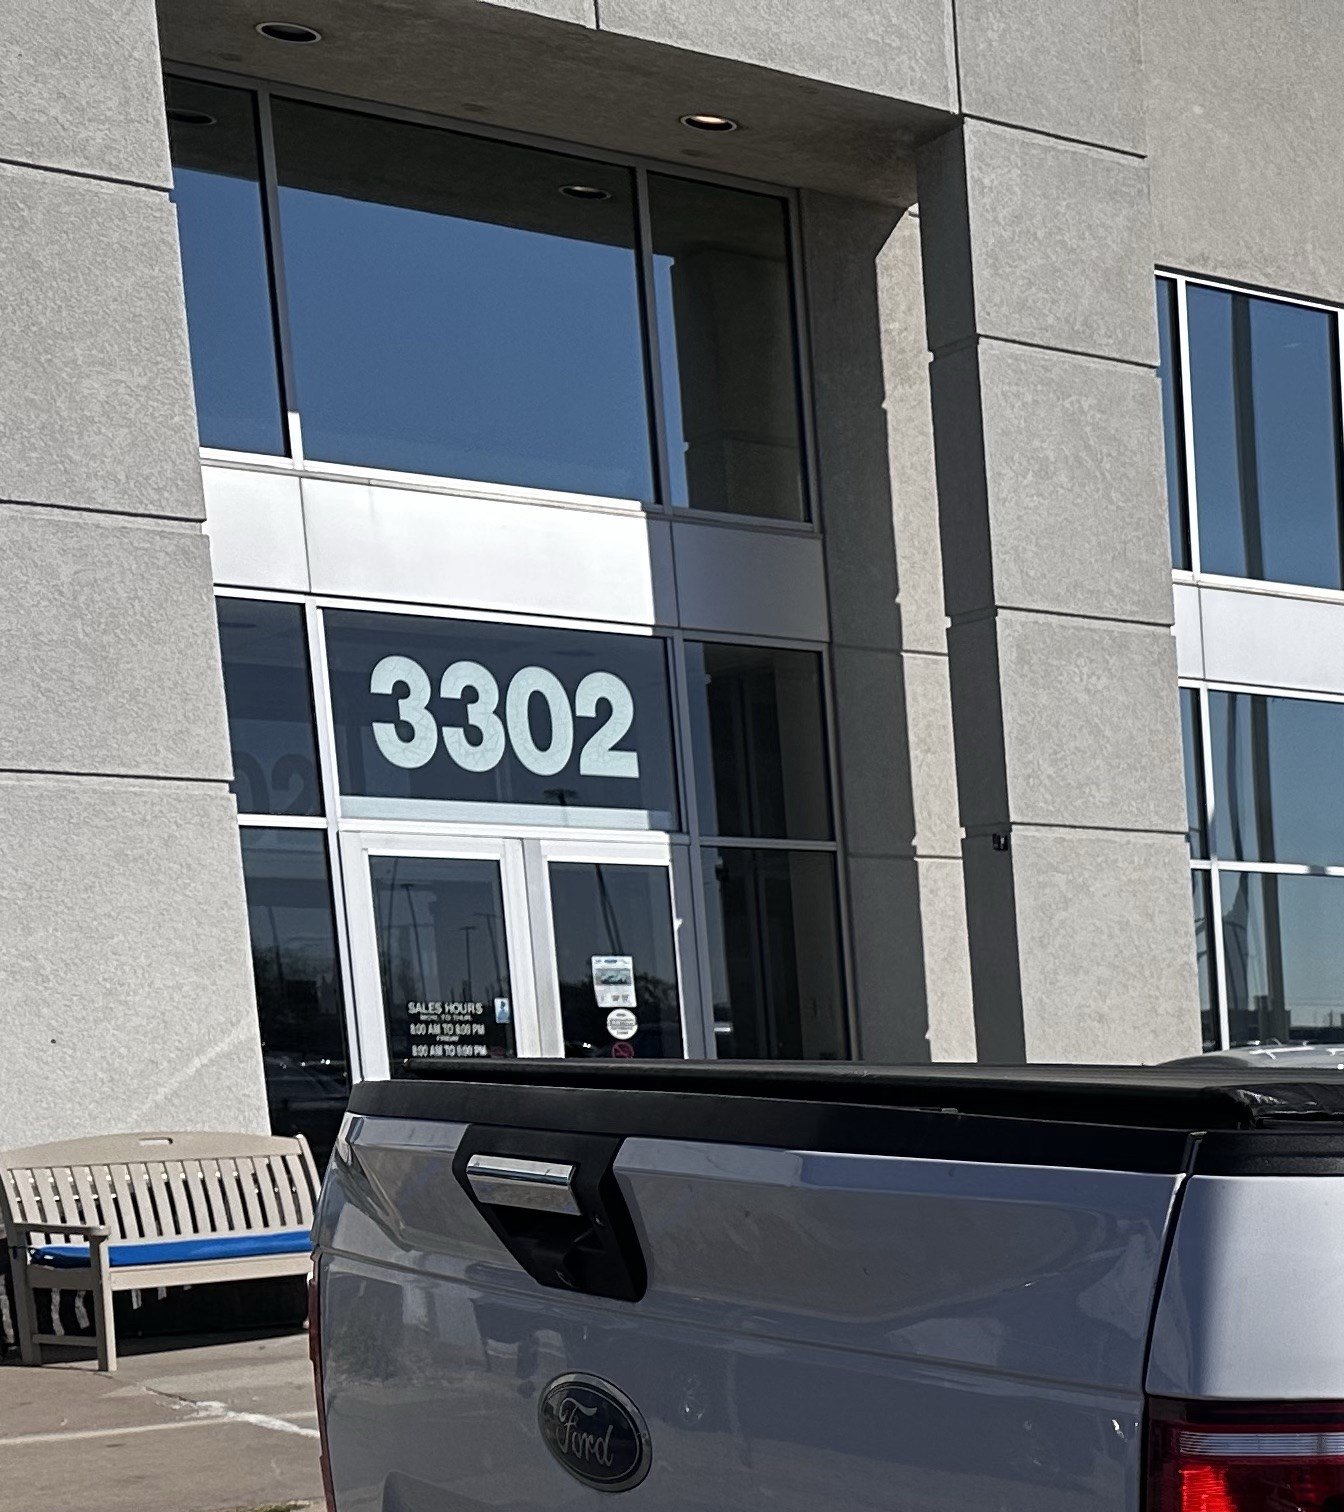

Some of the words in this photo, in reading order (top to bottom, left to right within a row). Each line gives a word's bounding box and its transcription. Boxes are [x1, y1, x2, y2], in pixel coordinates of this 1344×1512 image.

[370, 655, 640, 779] 3302
[407, 1001, 443, 1014] SALES
[444, 1002, 484, 1015] HOURS
[428, 1023, 441, 1035] AM
[442, 1023, 454, 1035] TO
[472, 1023, 485, 1036] PM
[430, 1044, 443, 1057] AM
[444, 1045, 456, 1057] TO
[556, 1397, 615, 1467] Ford
